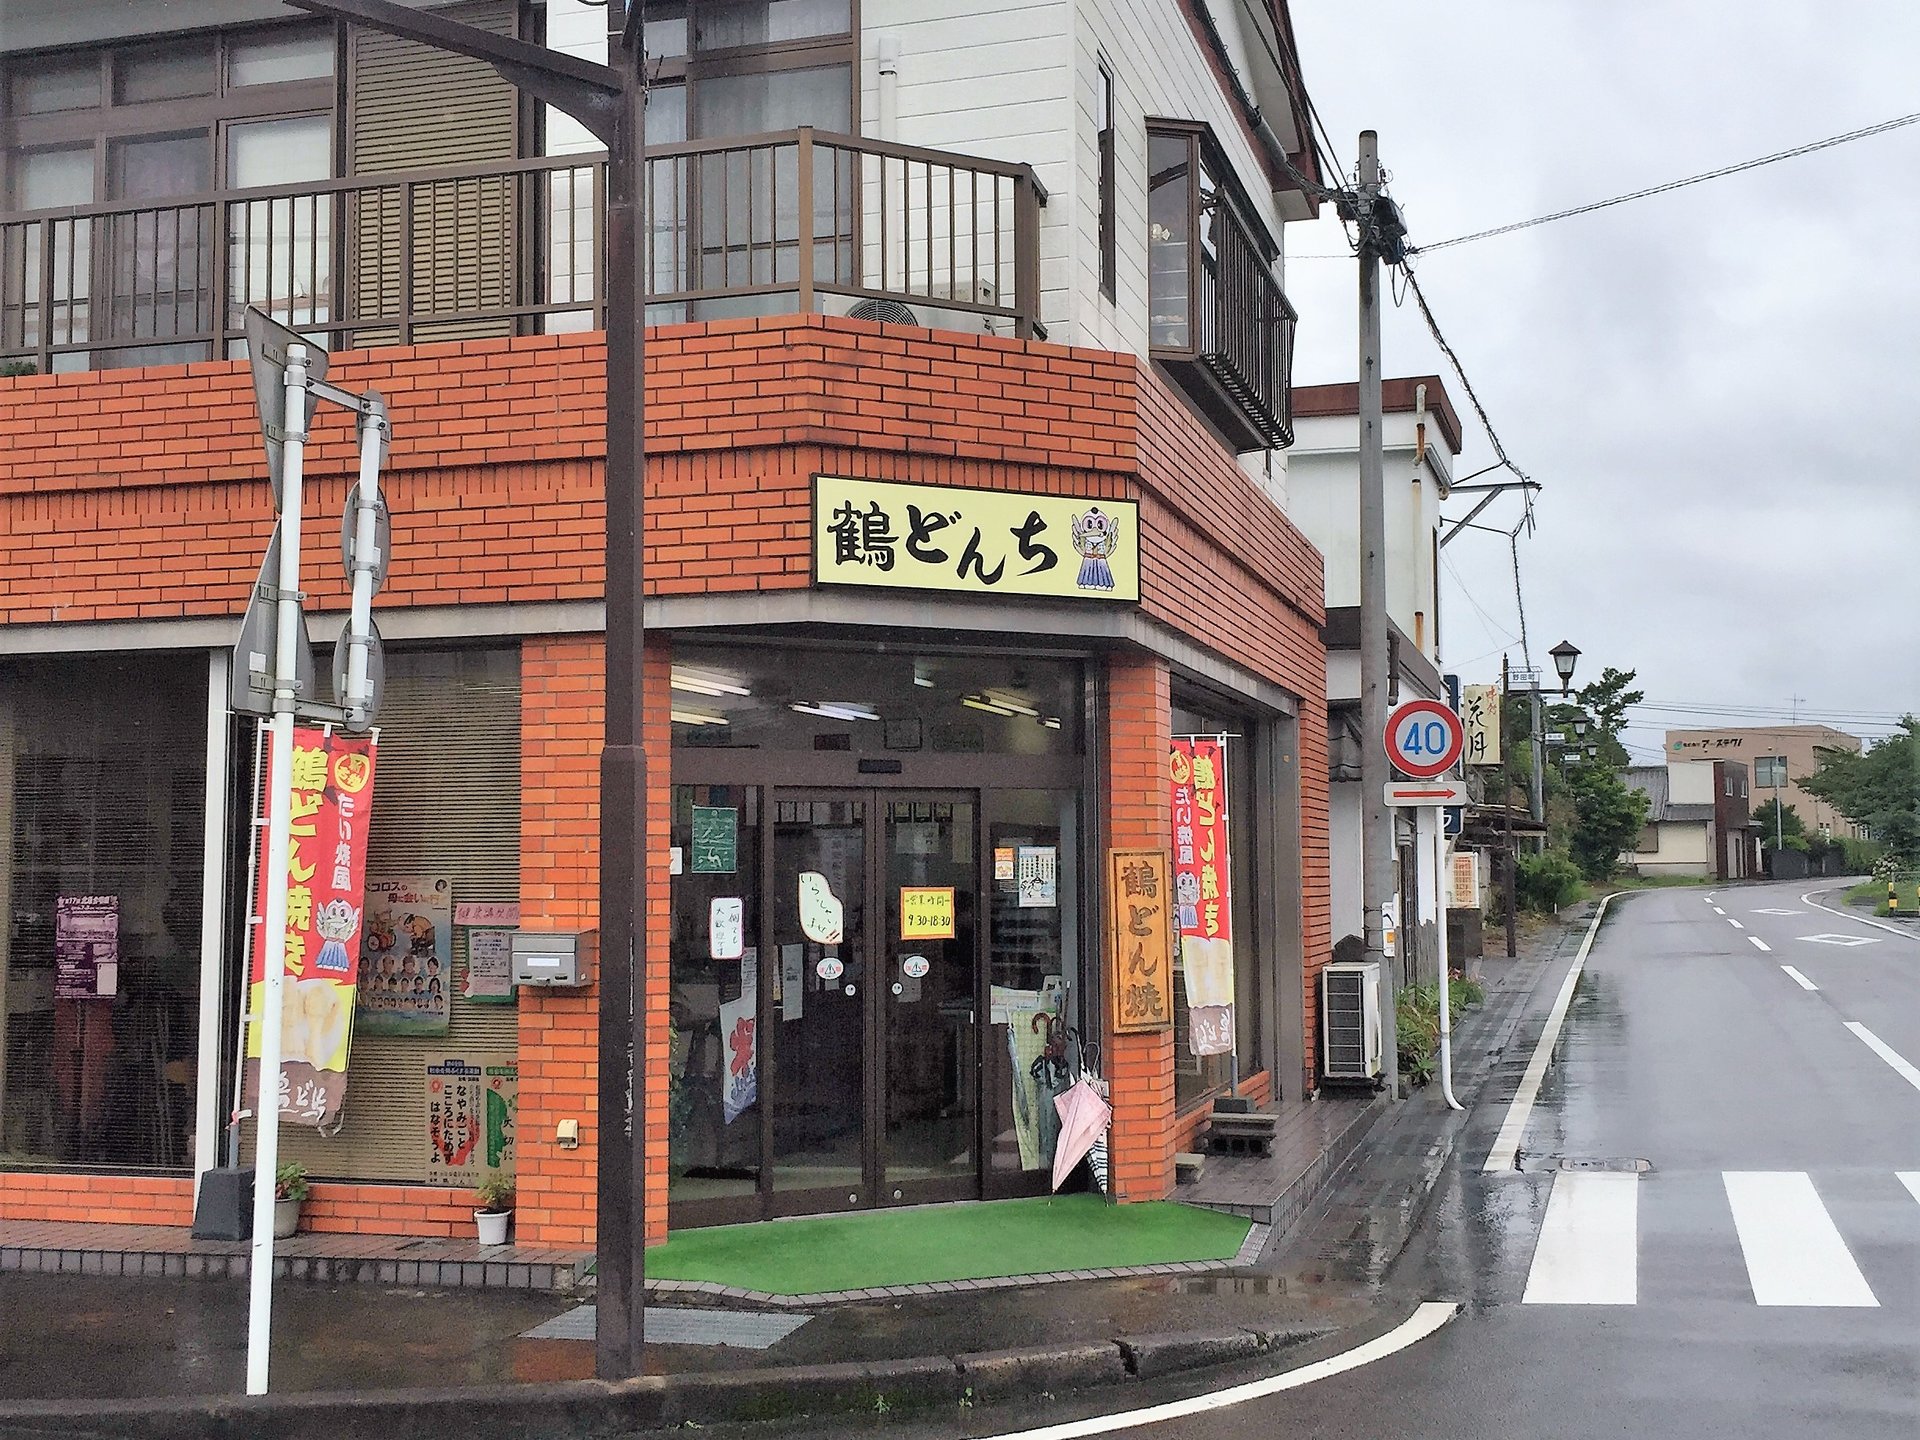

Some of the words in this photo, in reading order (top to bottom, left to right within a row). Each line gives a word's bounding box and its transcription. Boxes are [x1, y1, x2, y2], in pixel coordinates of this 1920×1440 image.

[827, 500, 1058, 585] 鶴どんち
[1403, 722, 1446, 755] 40
[366, 881, 408, 892] コロスの
[1121, 861, 1164, 1018] 鶴どん焼
